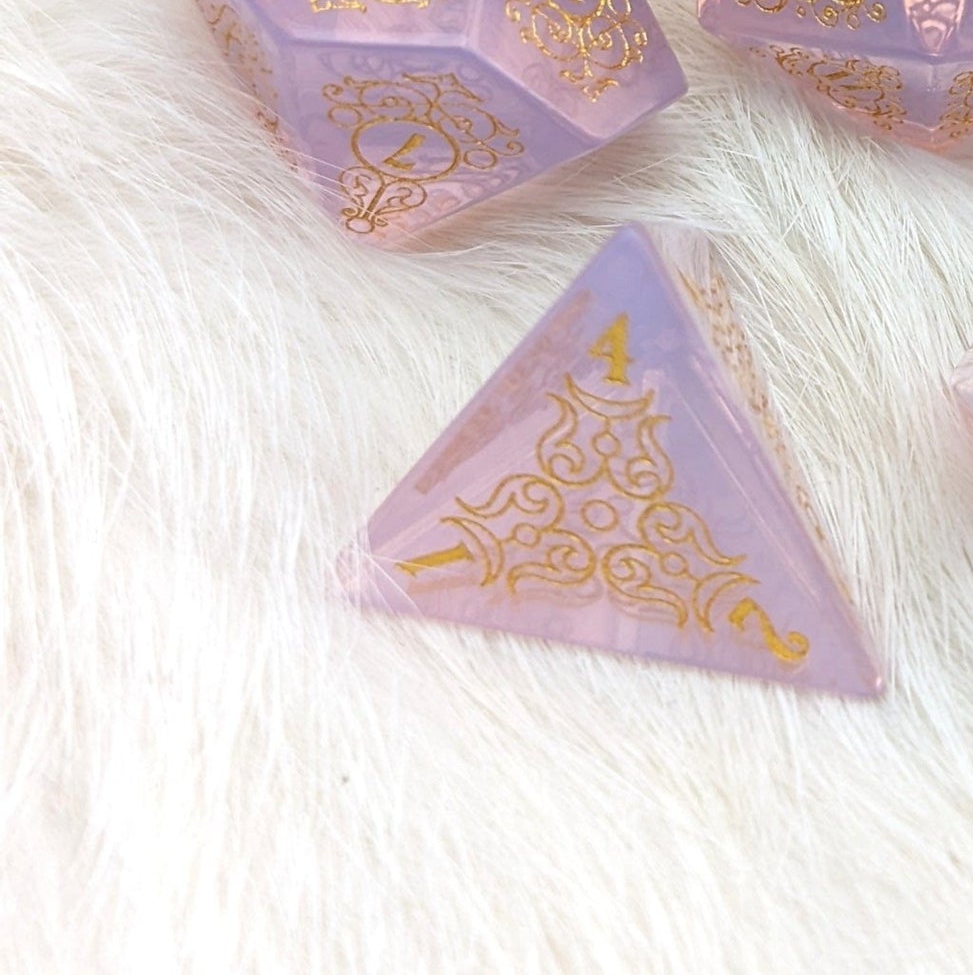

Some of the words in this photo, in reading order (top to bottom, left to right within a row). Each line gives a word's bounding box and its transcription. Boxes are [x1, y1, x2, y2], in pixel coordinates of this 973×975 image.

[589, 313, 635, 385] 4
[395, 544, 472, 577] 1
[727, 597, 810, 664] 2
